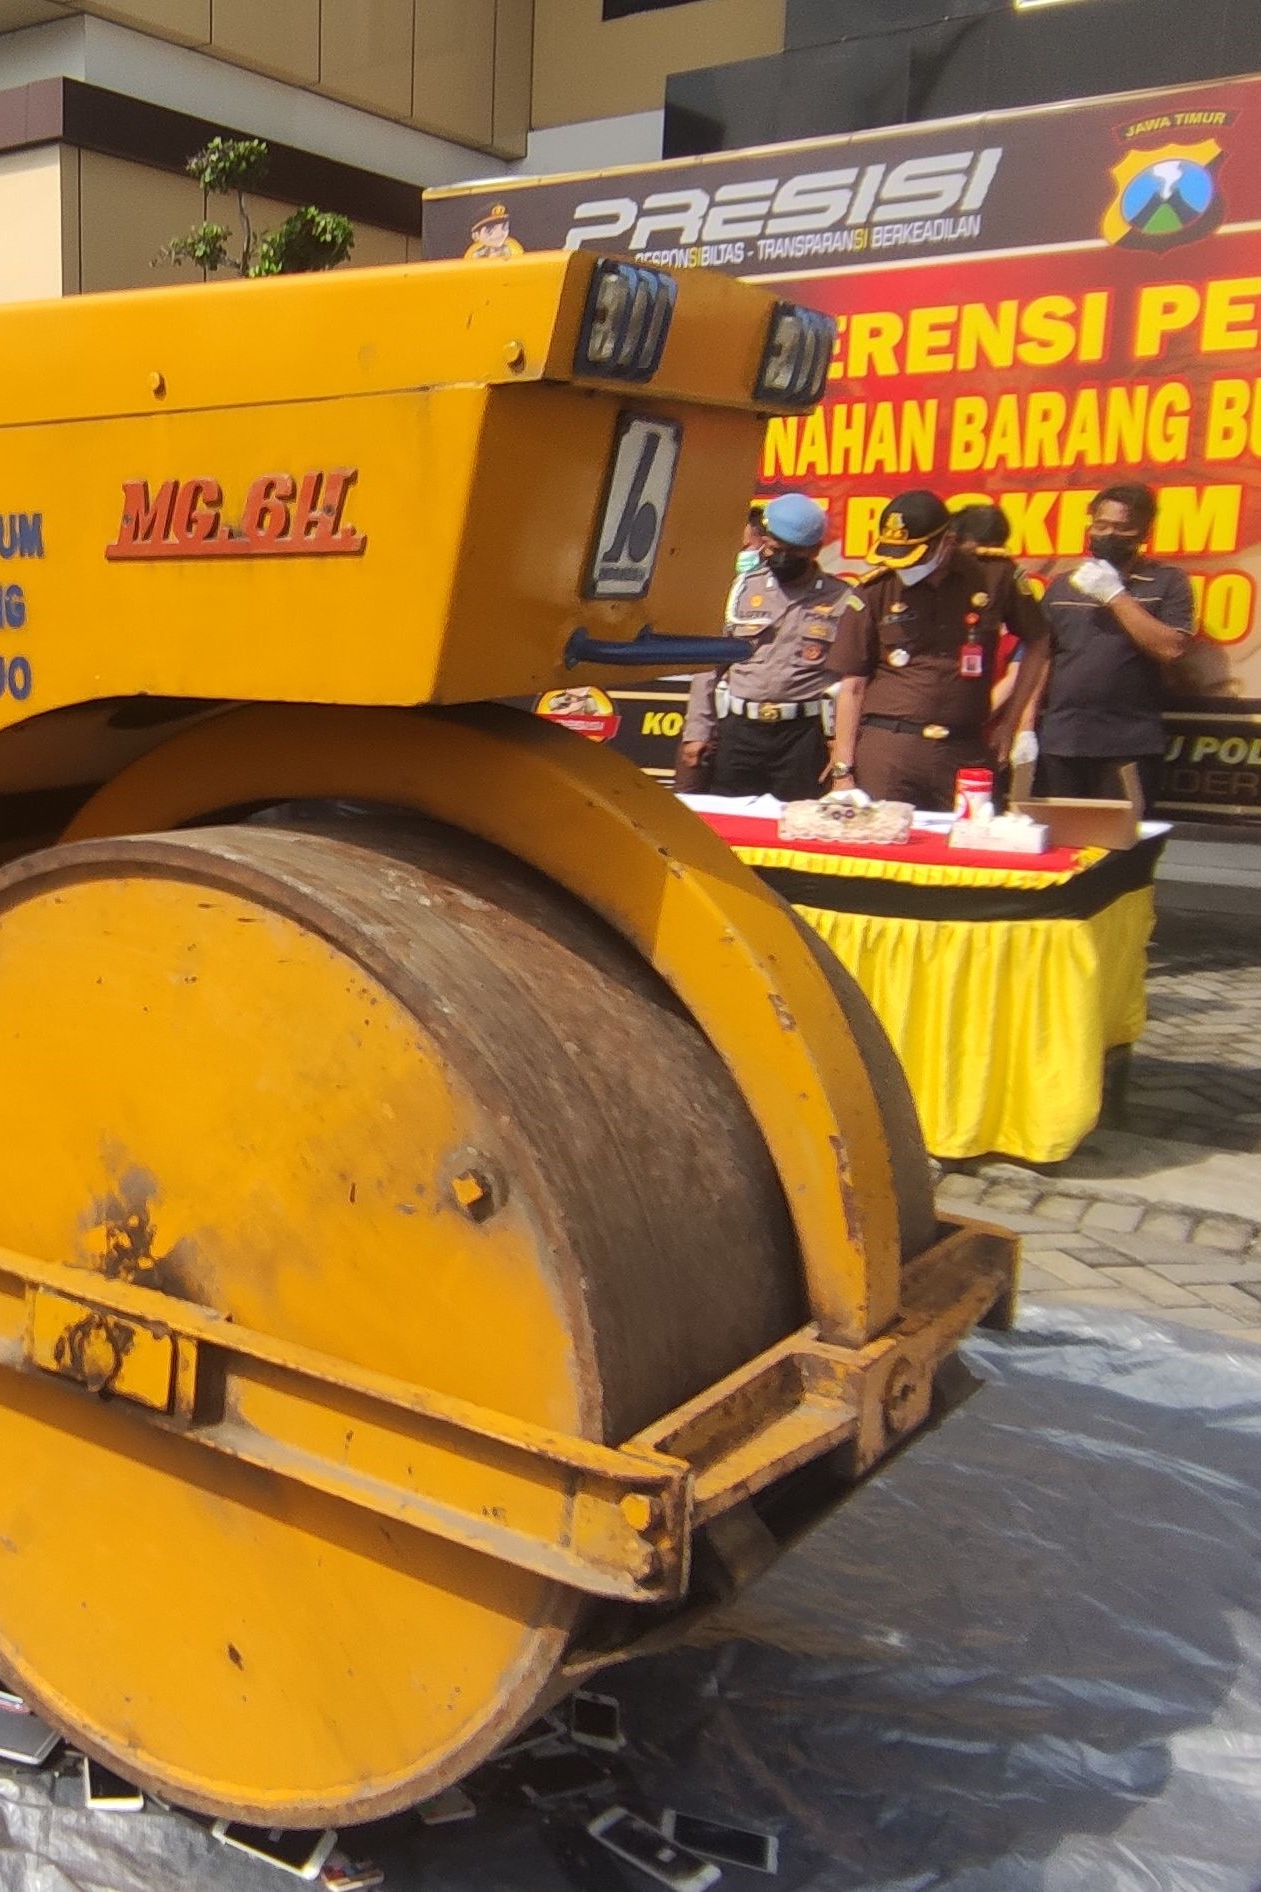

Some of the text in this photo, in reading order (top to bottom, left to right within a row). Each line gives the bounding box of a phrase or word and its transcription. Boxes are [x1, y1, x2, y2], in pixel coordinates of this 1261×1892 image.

[1125, 111, 1227, 137] JAWA TIMUR
[563, 147, 1003, 250] PRESISI
[757, 228, 869, 261] TRANSPARANSI
[871, 215, 981, 248] BERKEADILAN
[950, 382, 1192, 472] BARANG
